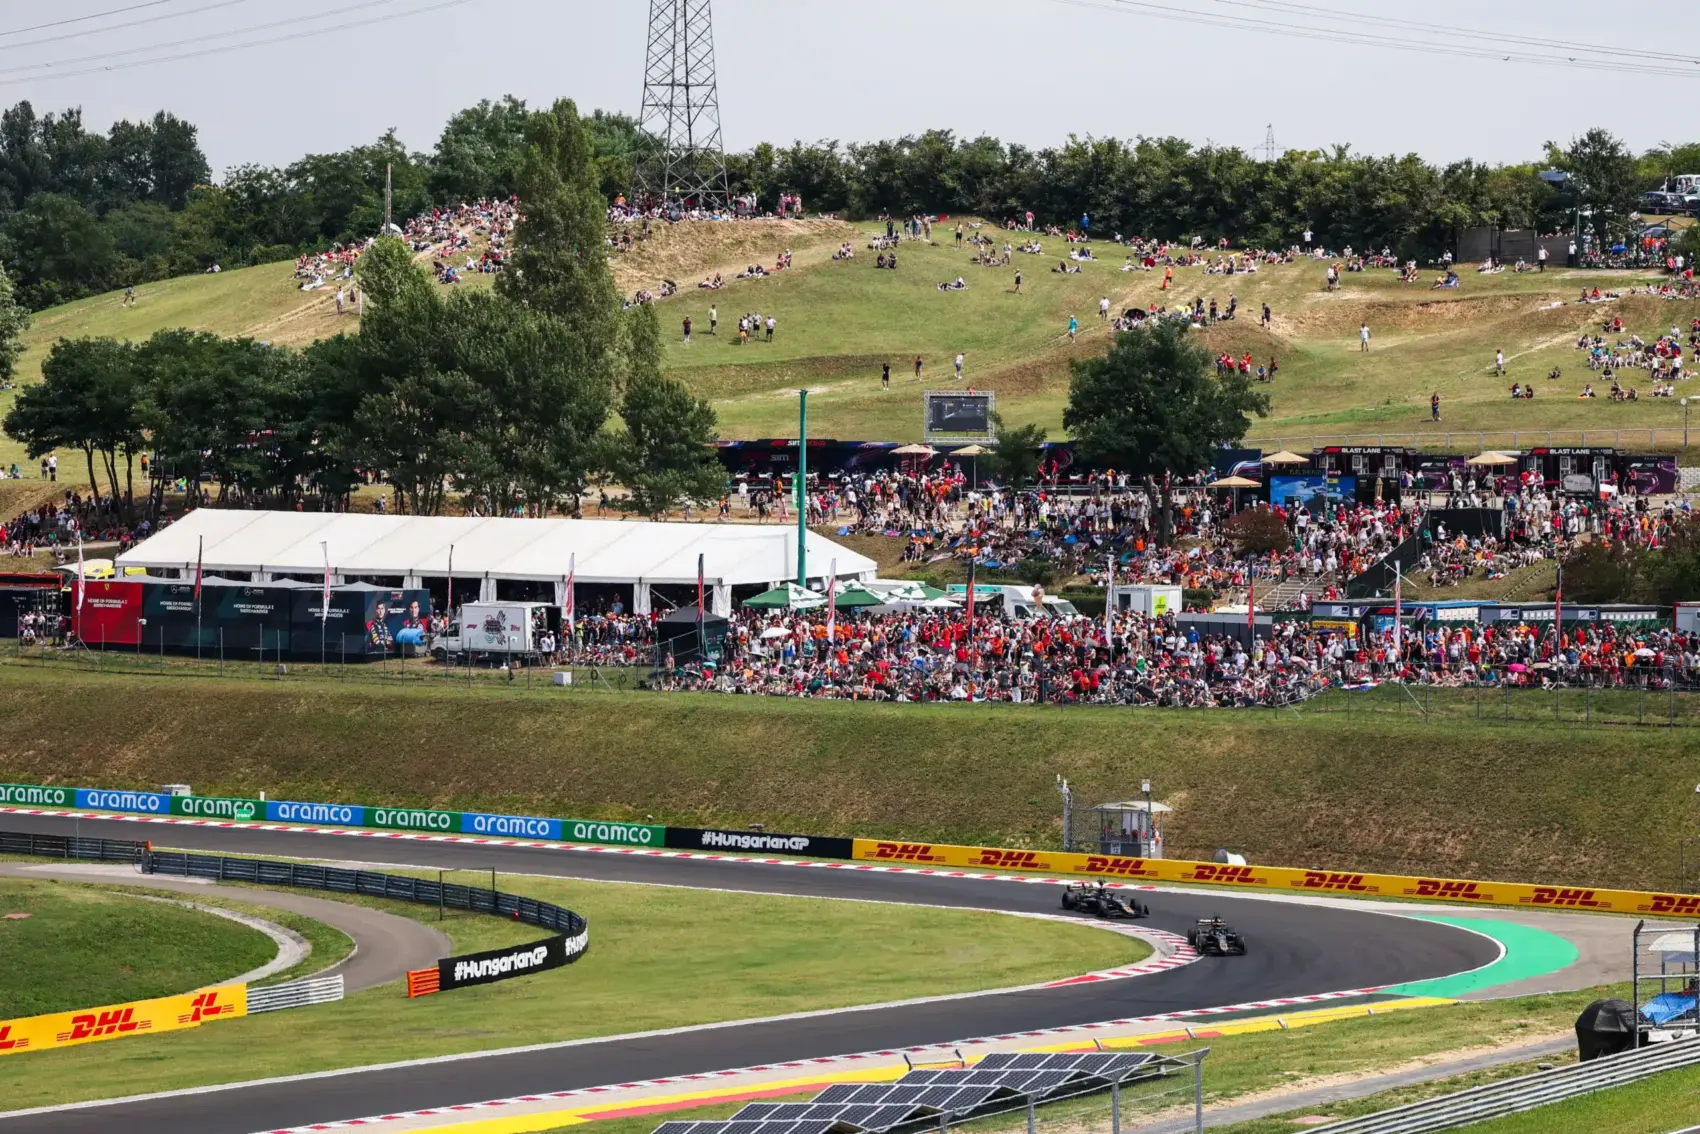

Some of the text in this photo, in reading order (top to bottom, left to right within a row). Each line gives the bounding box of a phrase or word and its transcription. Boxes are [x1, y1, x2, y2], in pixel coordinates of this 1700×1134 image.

[87, 790, 160, 811] aramco
[278, 803, 353, 823] aramco
[375, 810, 450, 829] aramco
[474, 814, 549, 836] aramco
[574, 823, 651, 843] aramco
[701, 831, 810, 851] #HungarianGP
[876, 843, 934, 861] DHL
[980, 850, 1040, 868] DHL
[1086, 857, 1146, 875] DHL
[1194, 865, 1256, 883] DHL
[1303, 872, 1368, 891] DHL
[1415, 880, 1481, 899] DHL
[1531, 888, 1599, 907] DHL
[454, 945, 548, 981] #HungarianGP
[69, 1007, 138, 1040] DHL
